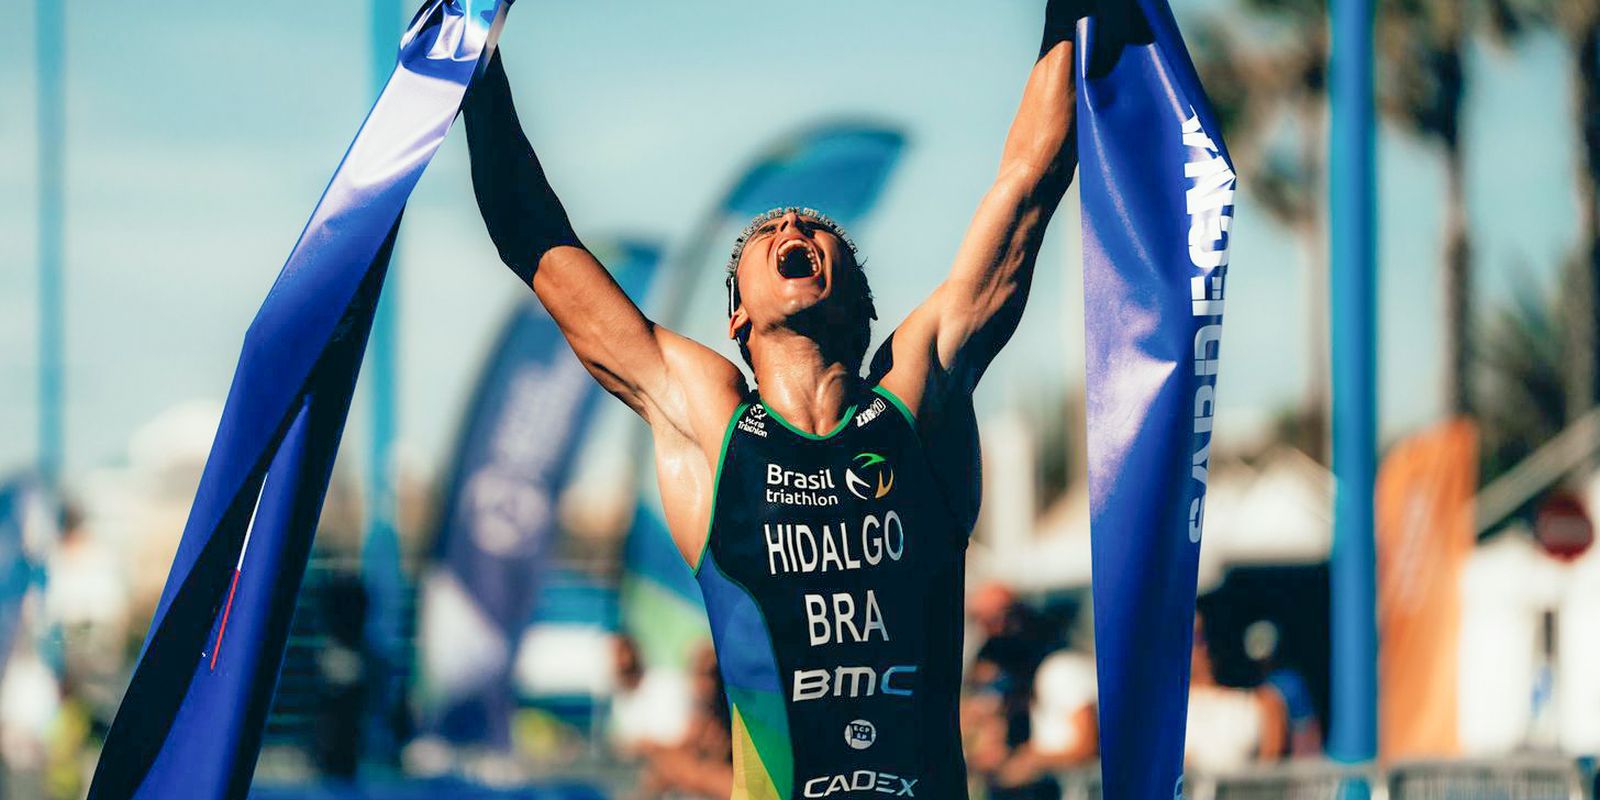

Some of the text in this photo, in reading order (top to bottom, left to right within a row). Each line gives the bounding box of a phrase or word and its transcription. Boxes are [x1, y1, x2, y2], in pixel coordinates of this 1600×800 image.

[738, 420, 768, 437] Triathlon
[766, 463, 836, 490] Brasil
[766, 488, 838, 506] triathlon
[764, 510, 904, 575] HIDALGO
[805, 590, 889, 646] BRA
[793, 665, 917, 702] BMC
[803, 770, 919, 798] CADEX
